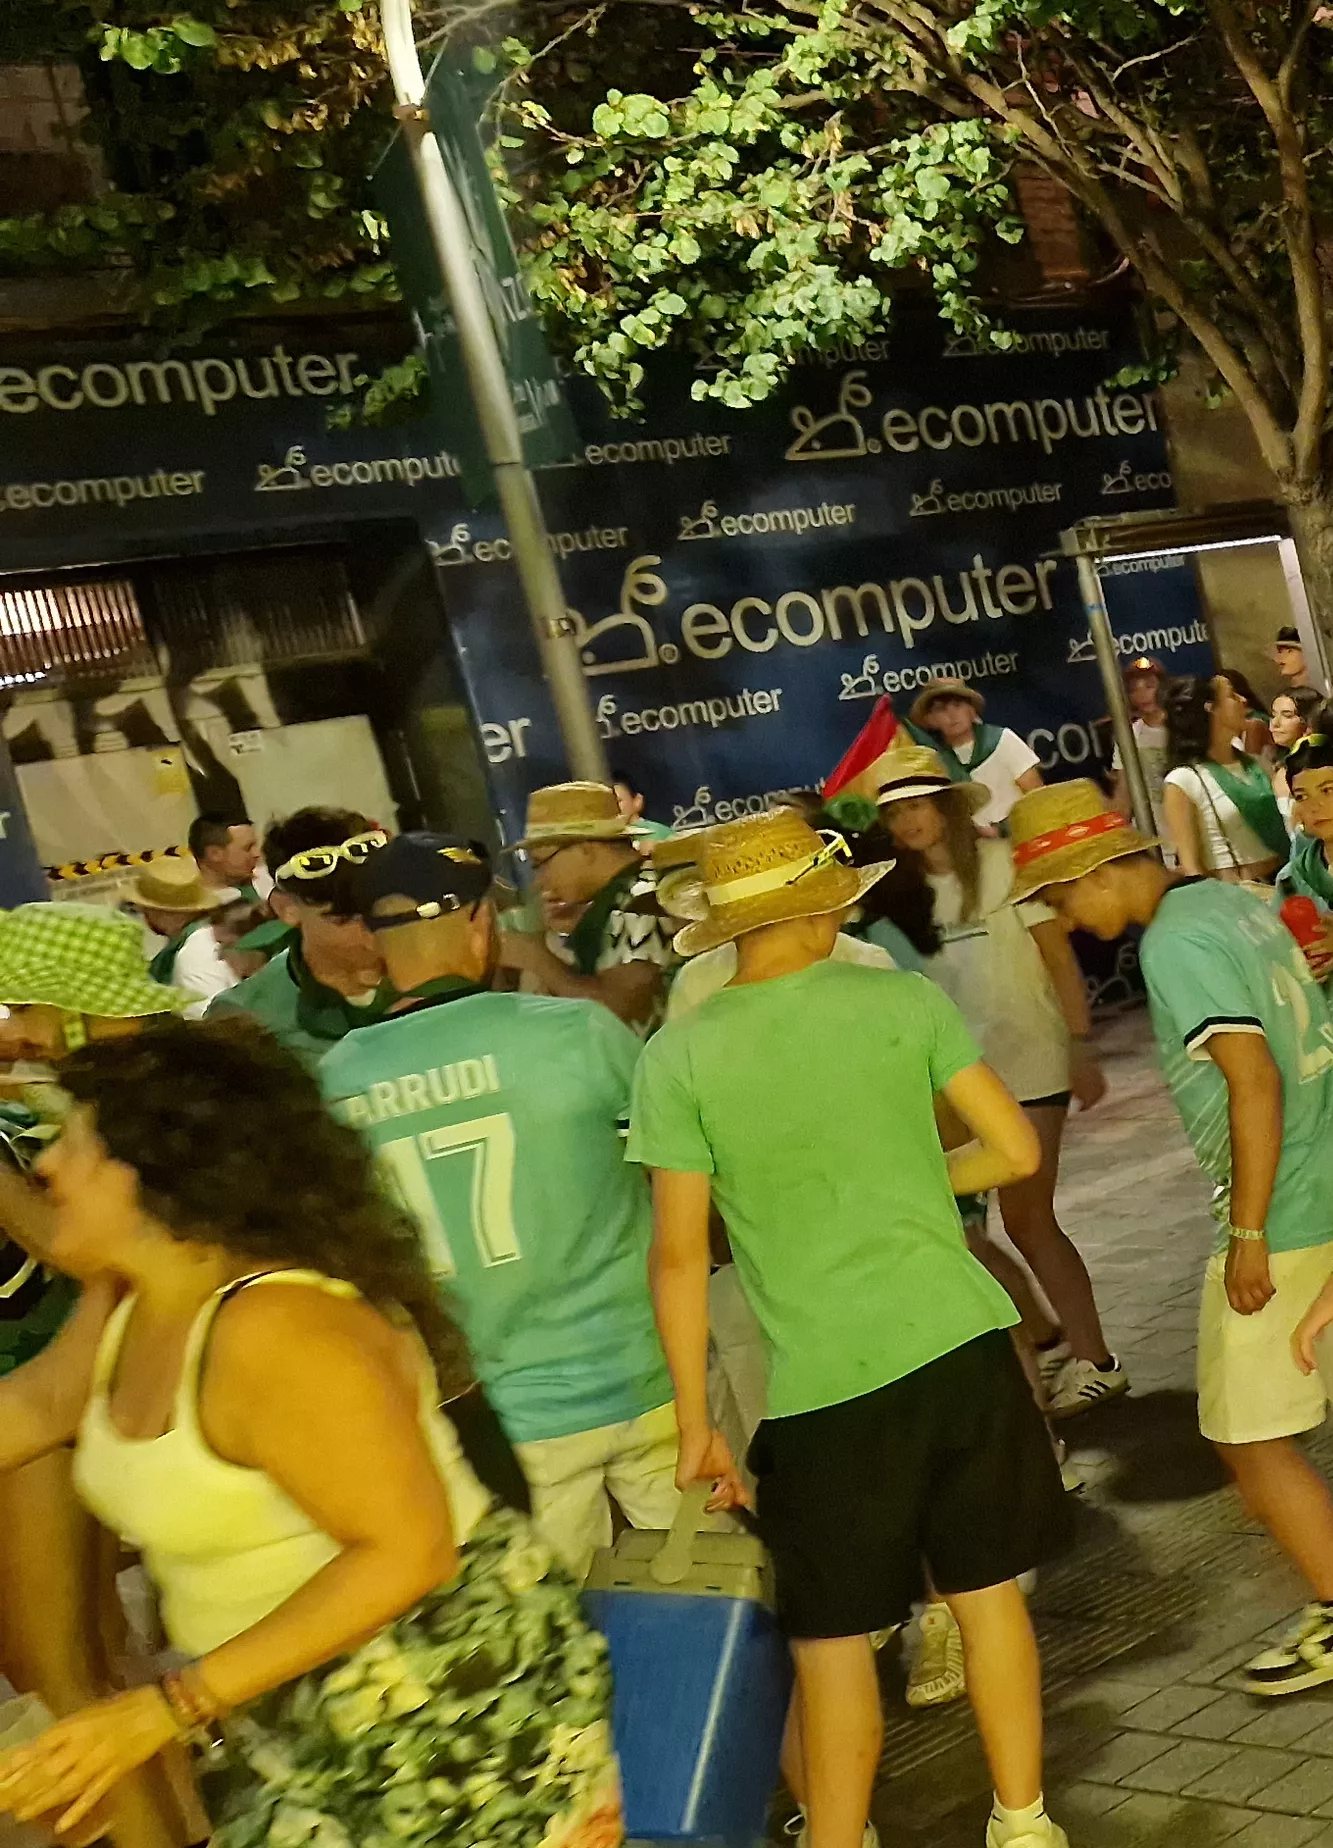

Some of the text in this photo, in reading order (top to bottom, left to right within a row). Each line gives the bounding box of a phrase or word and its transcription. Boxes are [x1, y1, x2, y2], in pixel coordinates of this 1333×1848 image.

[0, 344, 360, 416] ecomputer
[310, 450, 462, 488] ecomput
[947, 482, 1063, 512] ecomputer
[720, 500, 857, 537] ecomputer
[471, 525, 629, 563] ecputer
[621, 687, 783, 736] ecomputer
[374, 1111, 525, 1283] 17
